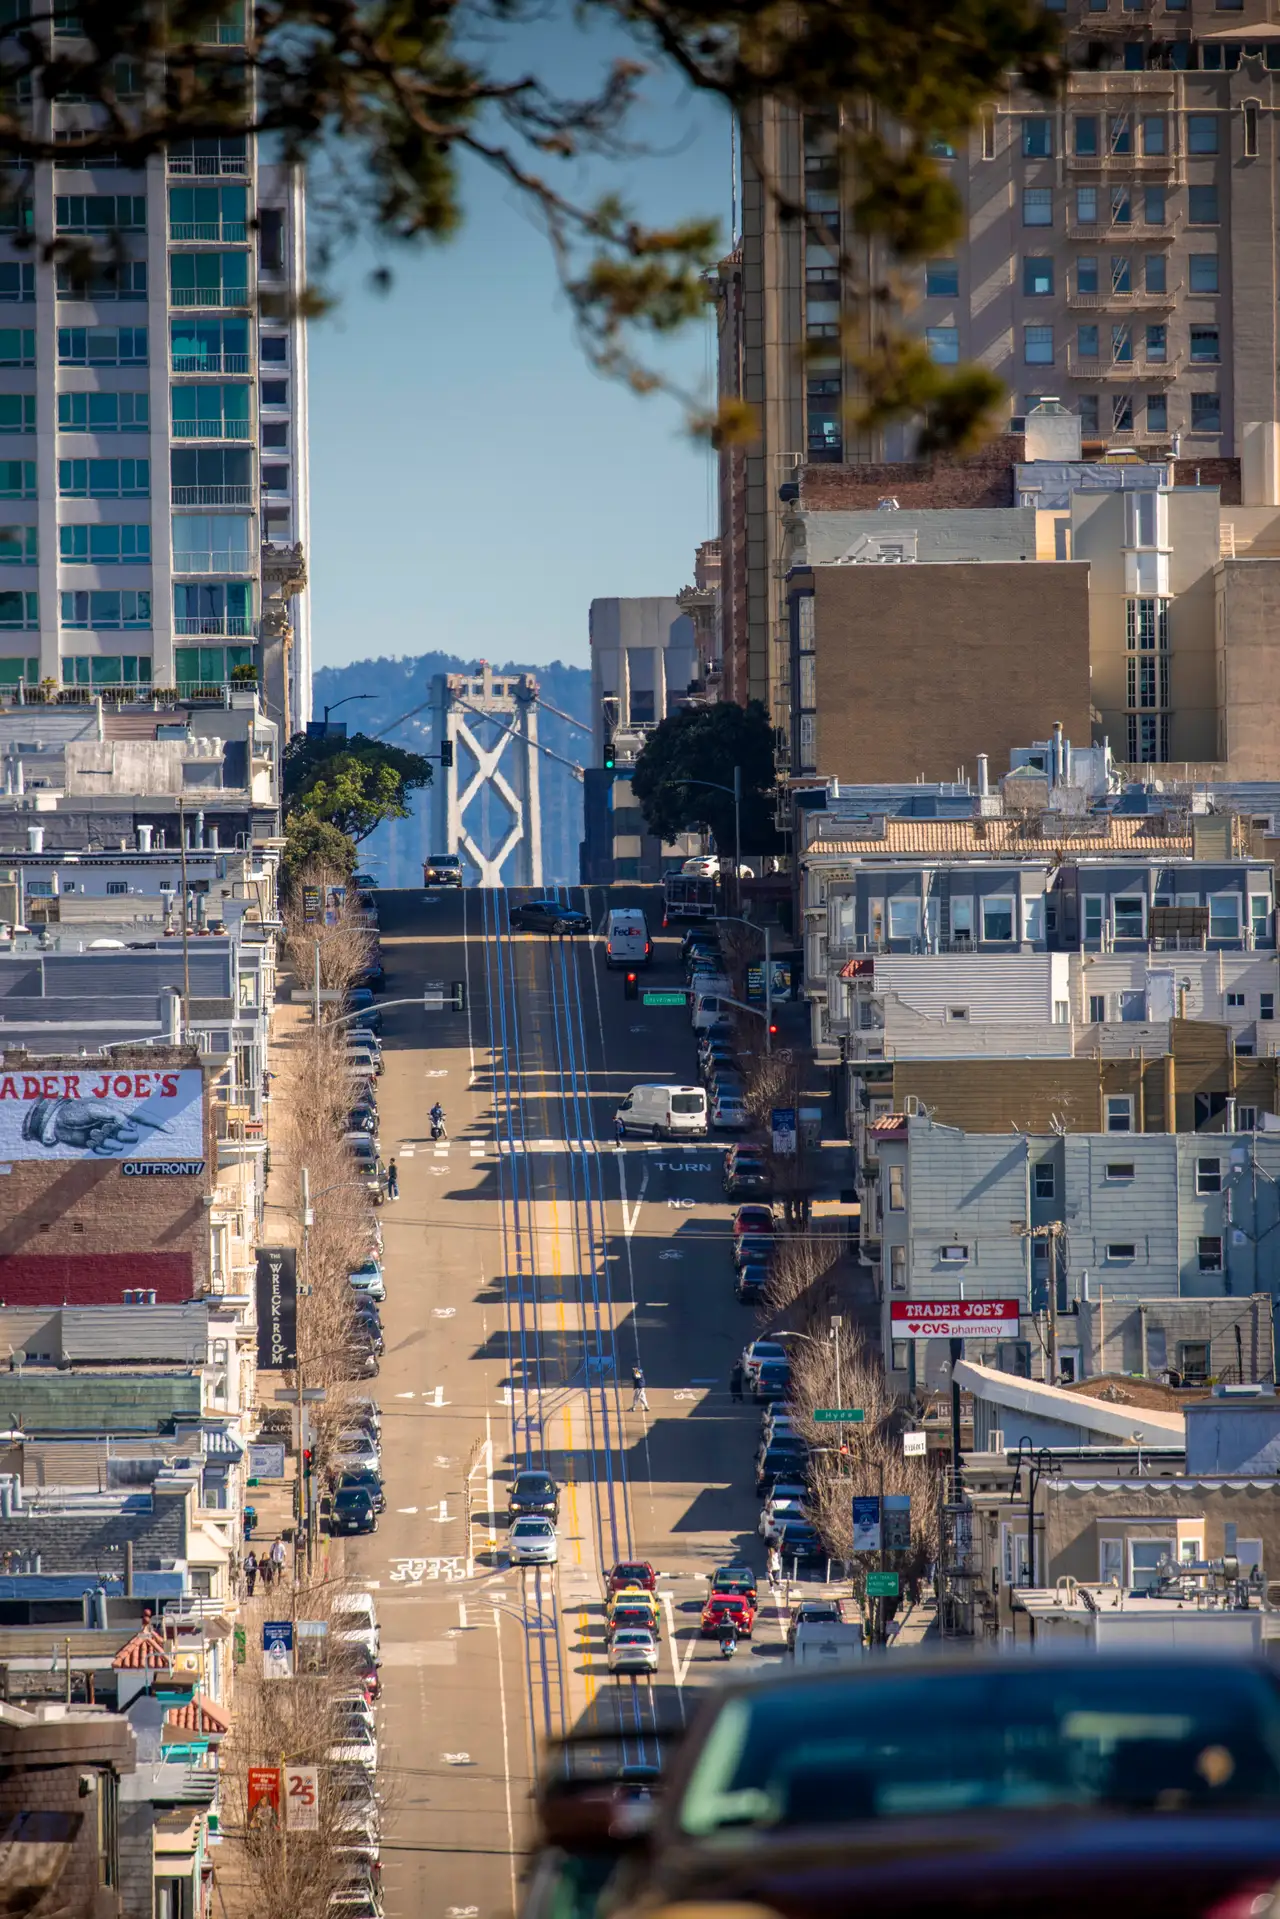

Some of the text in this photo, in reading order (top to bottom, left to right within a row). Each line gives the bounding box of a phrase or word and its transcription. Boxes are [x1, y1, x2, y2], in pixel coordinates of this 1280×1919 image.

[614, 927, 641, 936] FedEx
[92, 1073, 180, 1098] JOE'S
[654, 1162, 711, 1171] TURN
[667, 1198, 696, 1208] NO
[269, 1263, 284, 1364] WRECK ROOM
[905, 1303, 1005, 1317] TRADER JOE'S
[922, 1323, 1003, 1335] CVS pharmacy
[825, 1412, 853, 1420] Hyde
[940, 1405, 973, 1416] HDE
[397, 1559, 457, 1571] KEEP
[389, 1569, 466, 1581] CLEAR
[289, 1775, 315, 1805] 25
